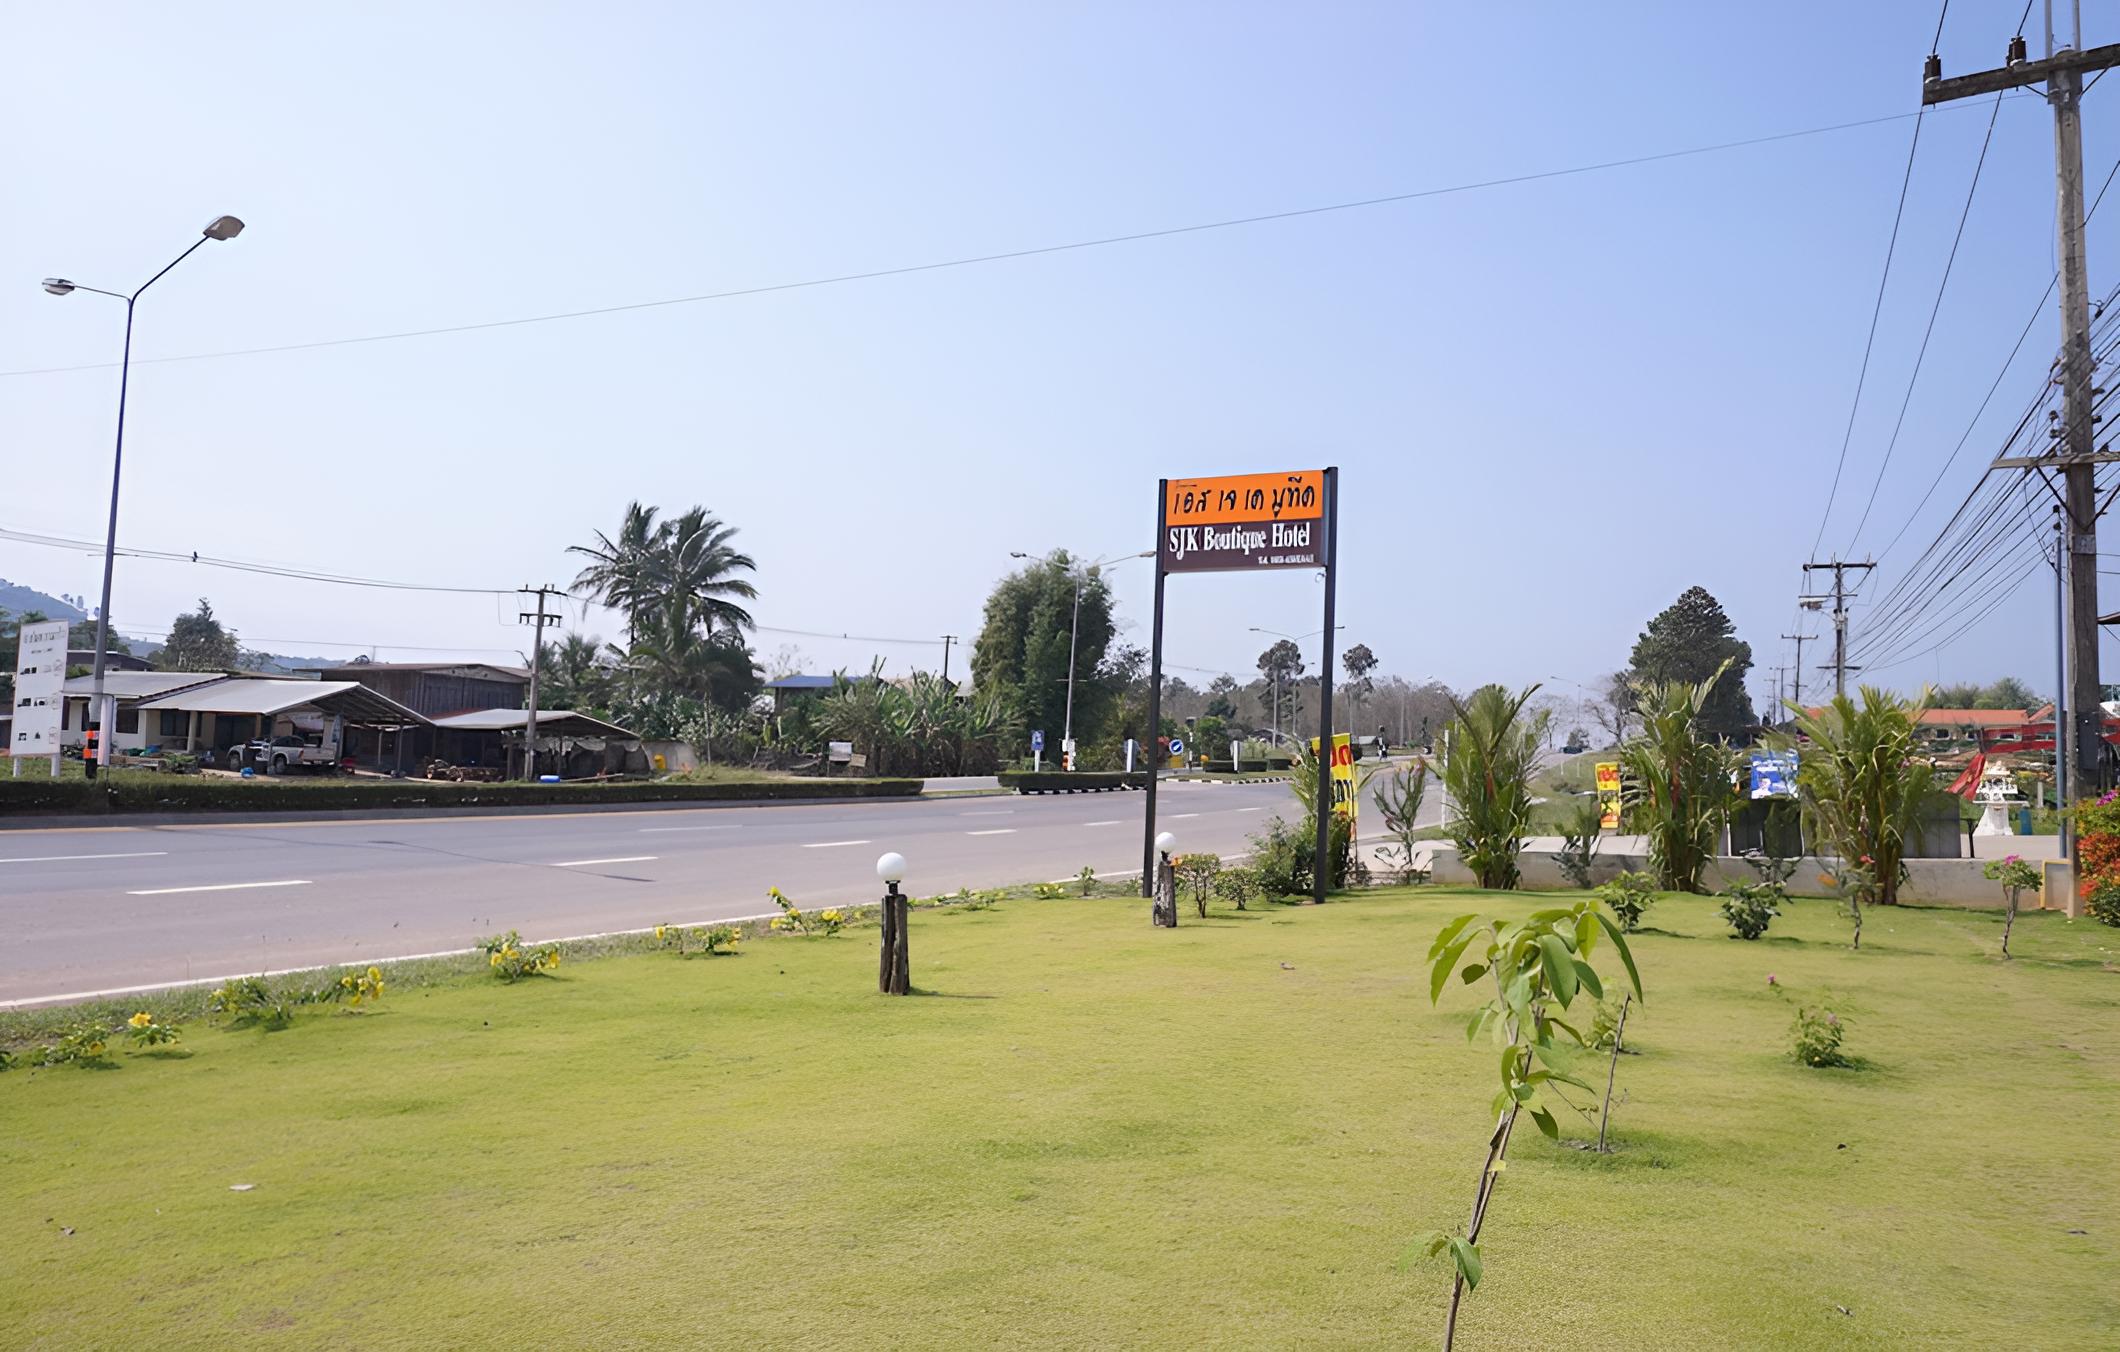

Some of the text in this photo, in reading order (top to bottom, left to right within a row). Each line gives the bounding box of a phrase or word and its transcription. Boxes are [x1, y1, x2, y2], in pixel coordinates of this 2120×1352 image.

[1169, 522, 1310, 560] SJK Boutique Hotel
